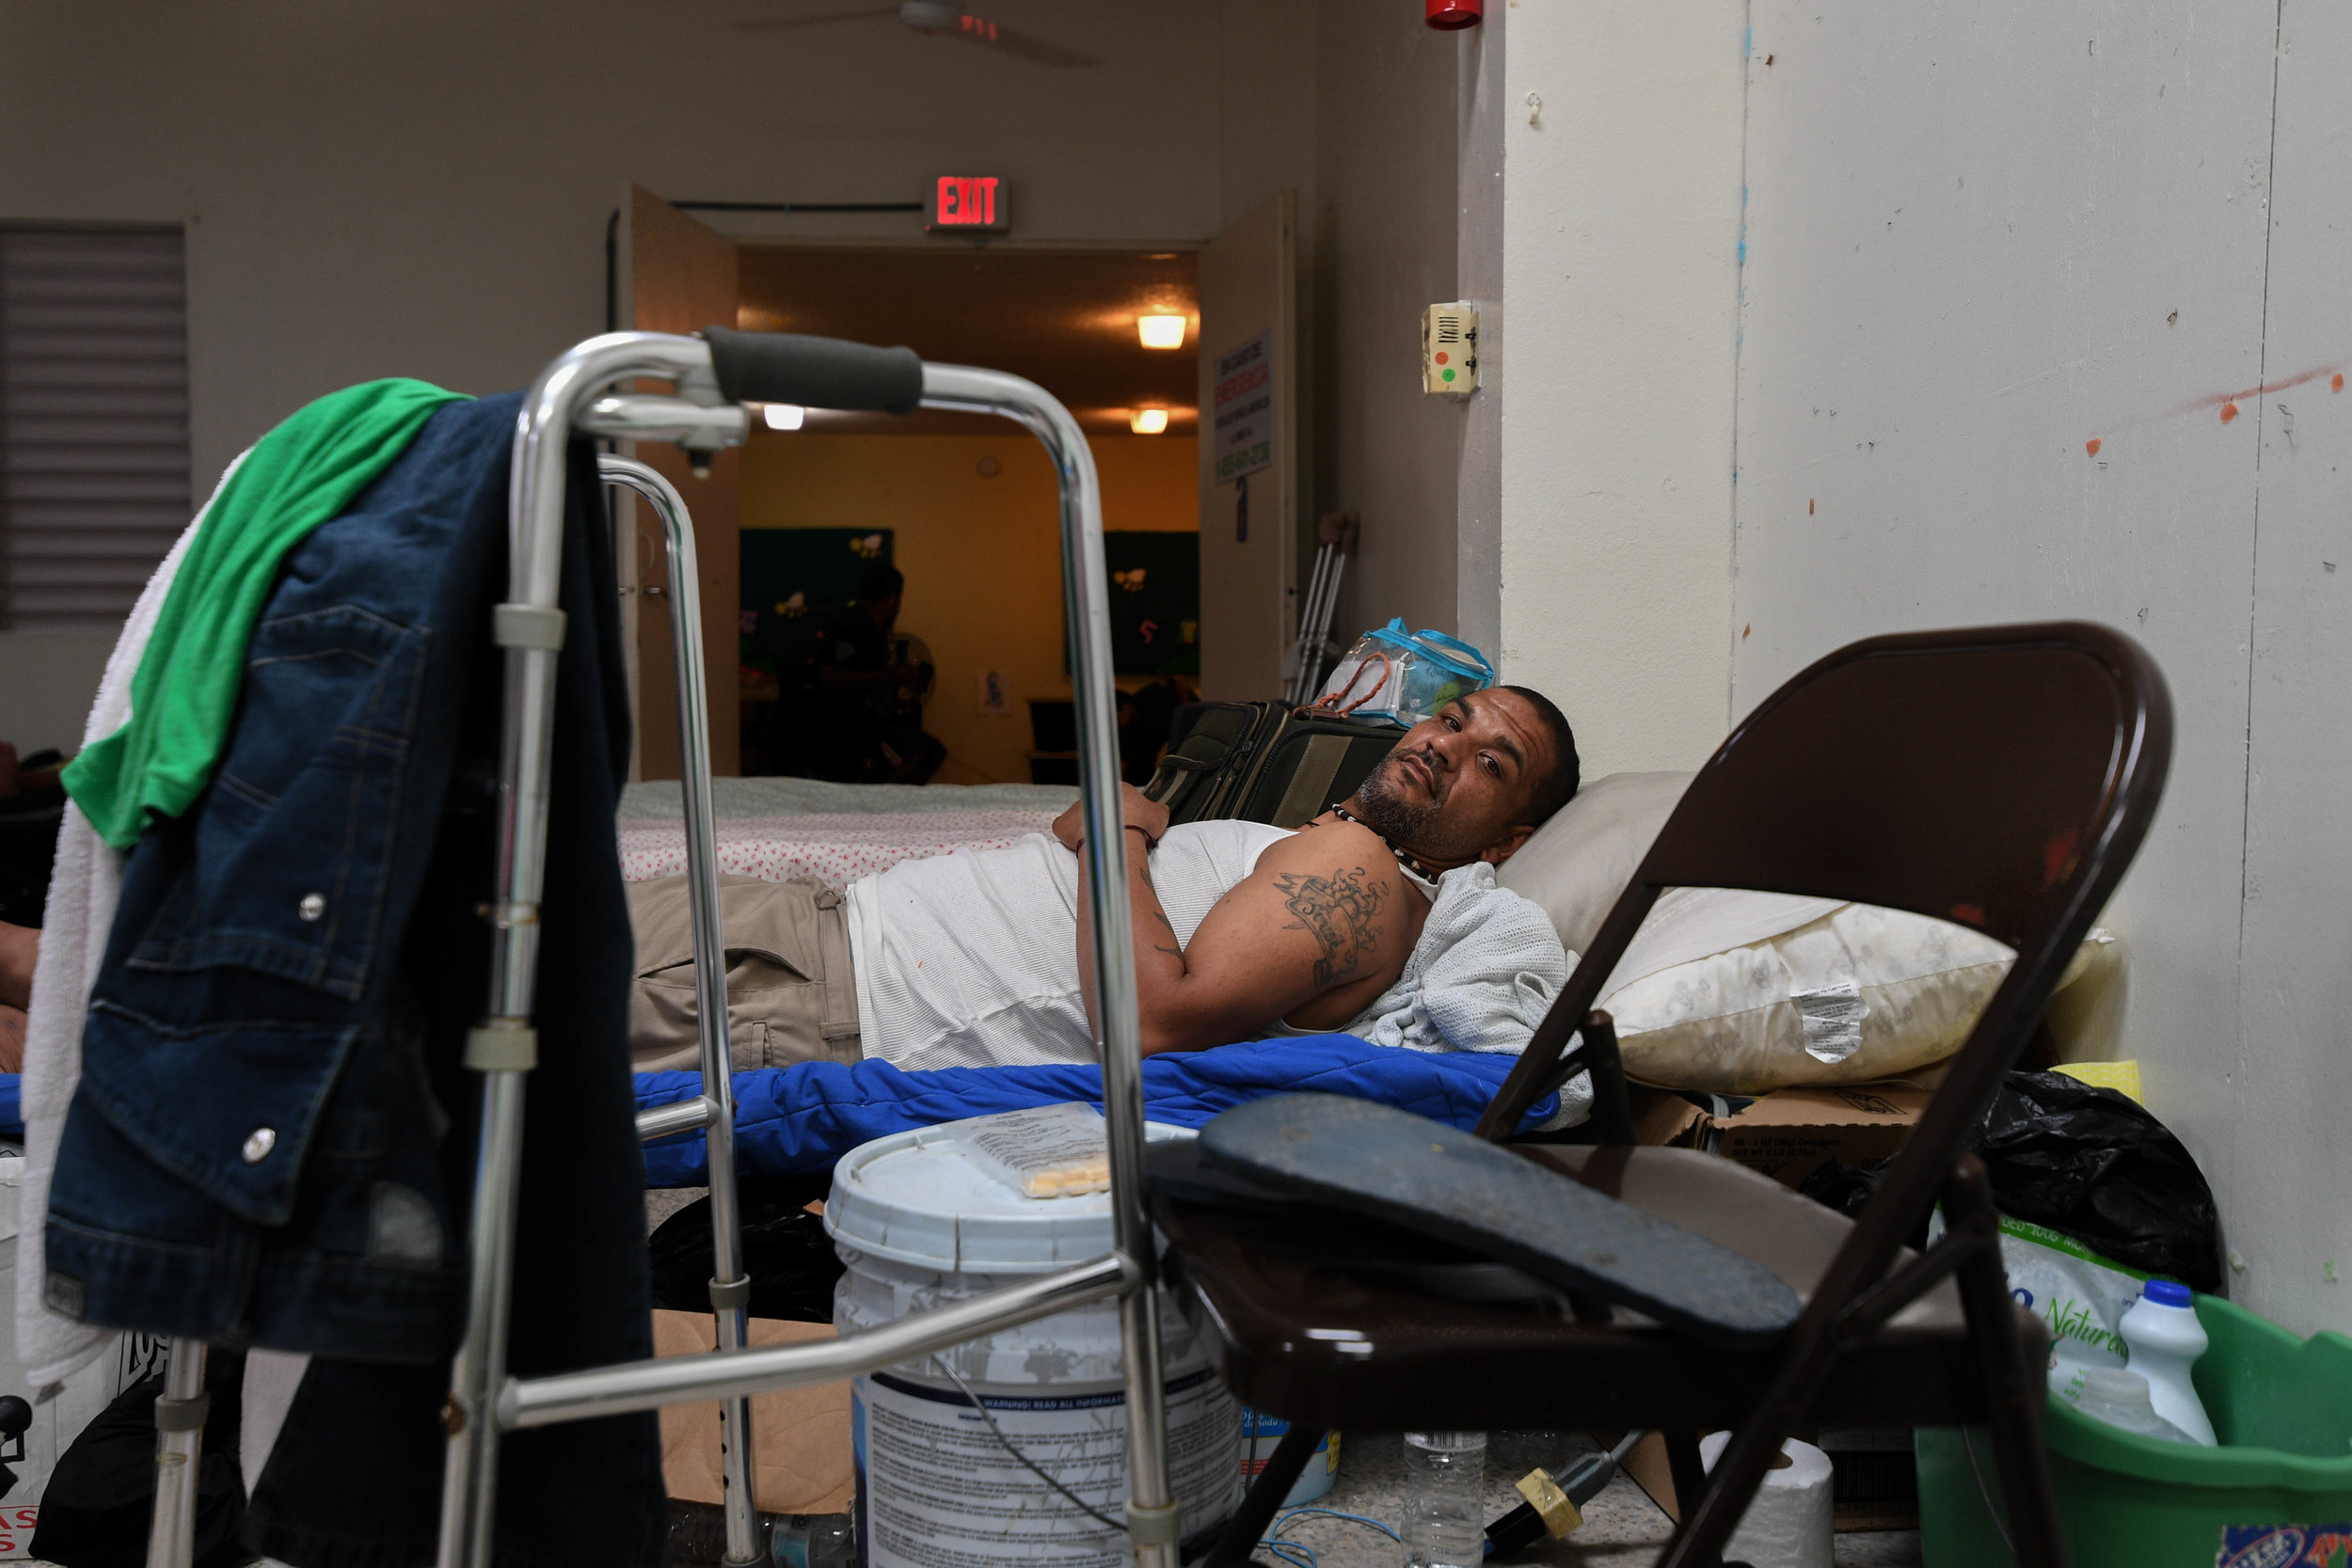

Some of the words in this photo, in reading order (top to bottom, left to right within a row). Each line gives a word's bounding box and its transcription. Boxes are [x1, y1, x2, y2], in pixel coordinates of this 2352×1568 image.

[937, 176, 999, 225] EXIT
[984, 1398, 1031, 1409] WARNING!
[1034, 1400, 1057, 1409] READ
